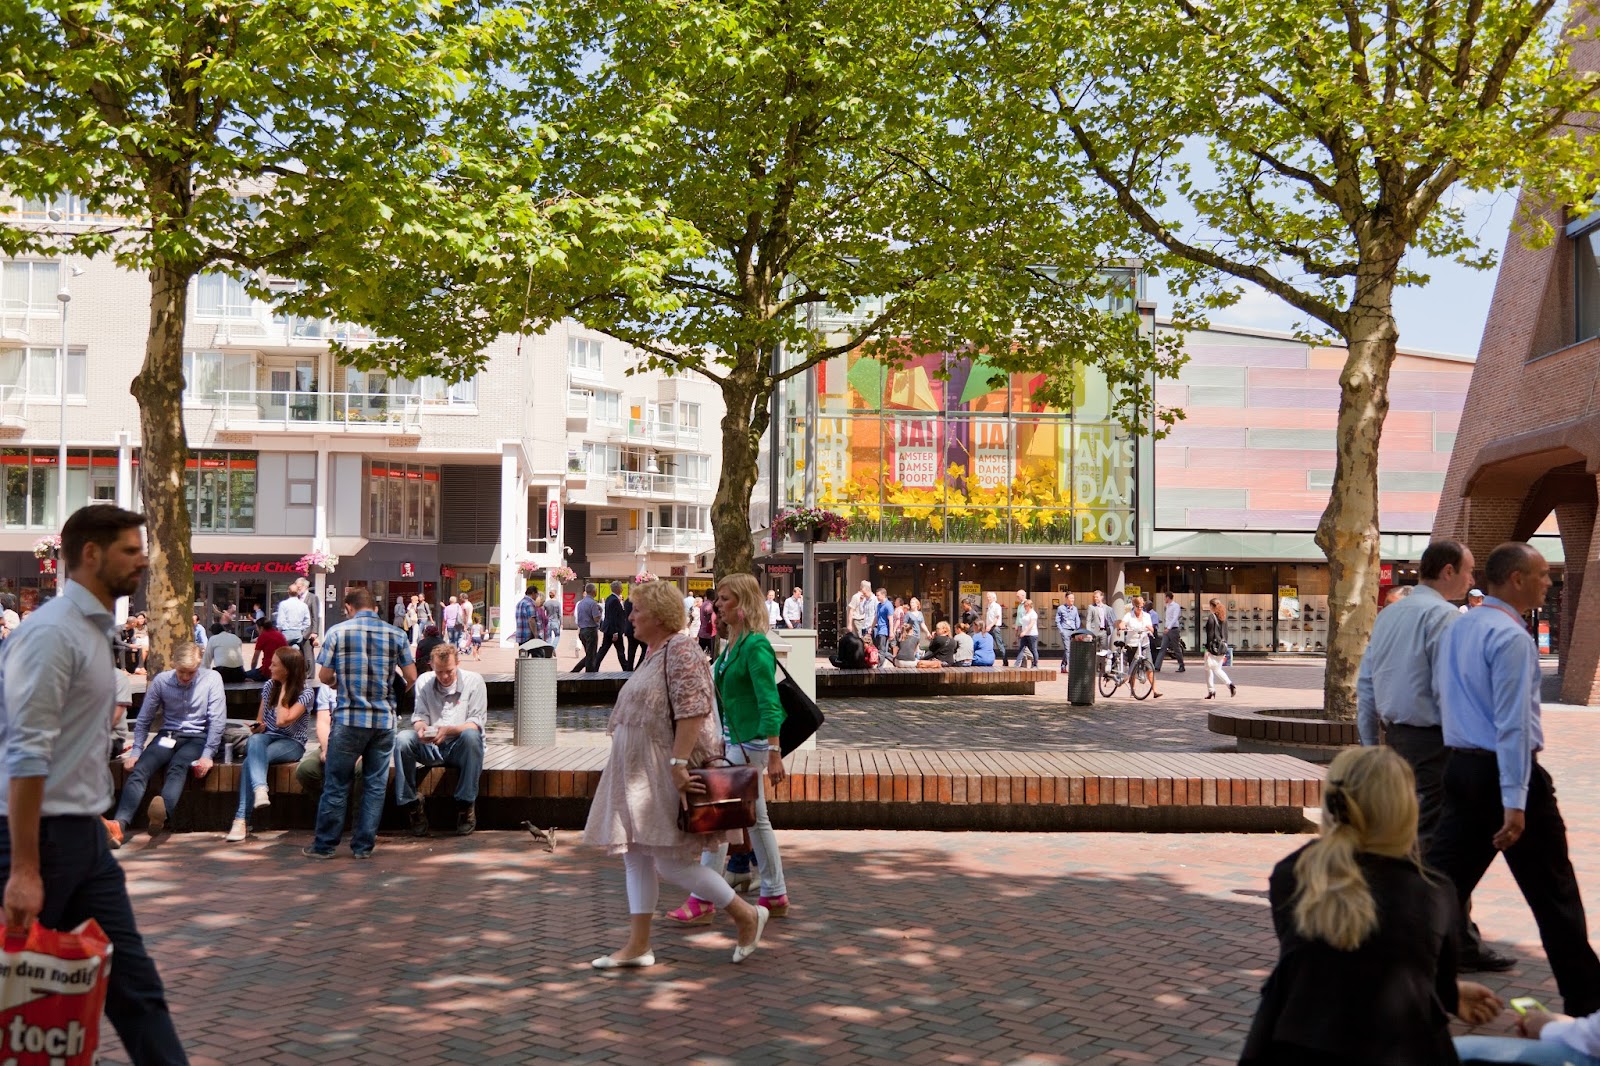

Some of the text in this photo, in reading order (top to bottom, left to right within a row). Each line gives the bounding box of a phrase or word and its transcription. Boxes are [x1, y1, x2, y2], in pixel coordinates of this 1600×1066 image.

[899, 452, 934, 461] AMSTER
[899, 463, 934, 472] DAMSE
[899, 473, 934, 483] POORT
[222, 561, 261, 573] Fried
[16, 961, 45, 979] dan
[9, 1015, 86, 1056] toch
